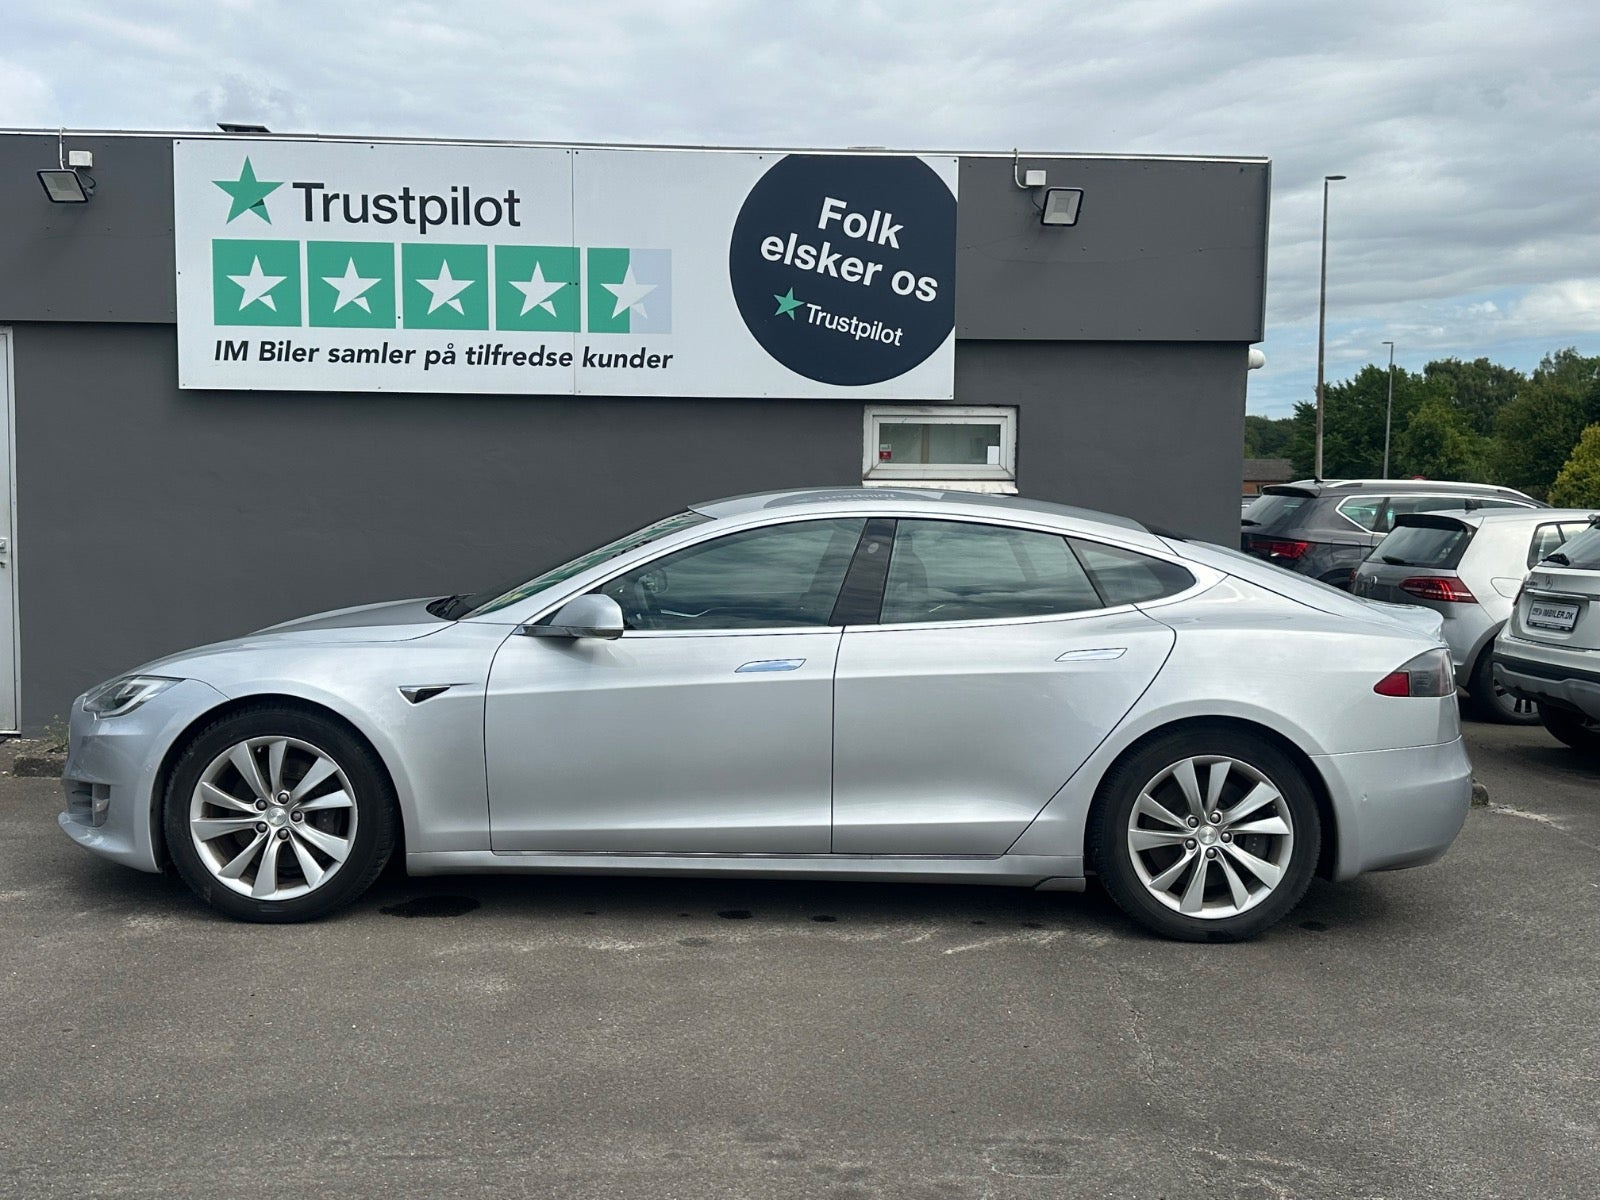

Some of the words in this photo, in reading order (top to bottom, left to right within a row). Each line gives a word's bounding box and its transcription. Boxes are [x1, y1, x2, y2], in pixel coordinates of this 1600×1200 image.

[292, 182, 521, 235] Trustpilot
[817, 196, 904, 249] Folk
[760, 232, 883, 286] elsker
[891, 270, 938, 302] os
[806, 303, 903, 347] Trustpilot
[214, 340, 249, 361] IM
[258, 341, 320, 363] Biler
[327, 341, 417, 365] samler
[424, 343, 456, 371] på
[465, 344, 573, 367] tilfredse
[582, 346, 674, 369] kunder
